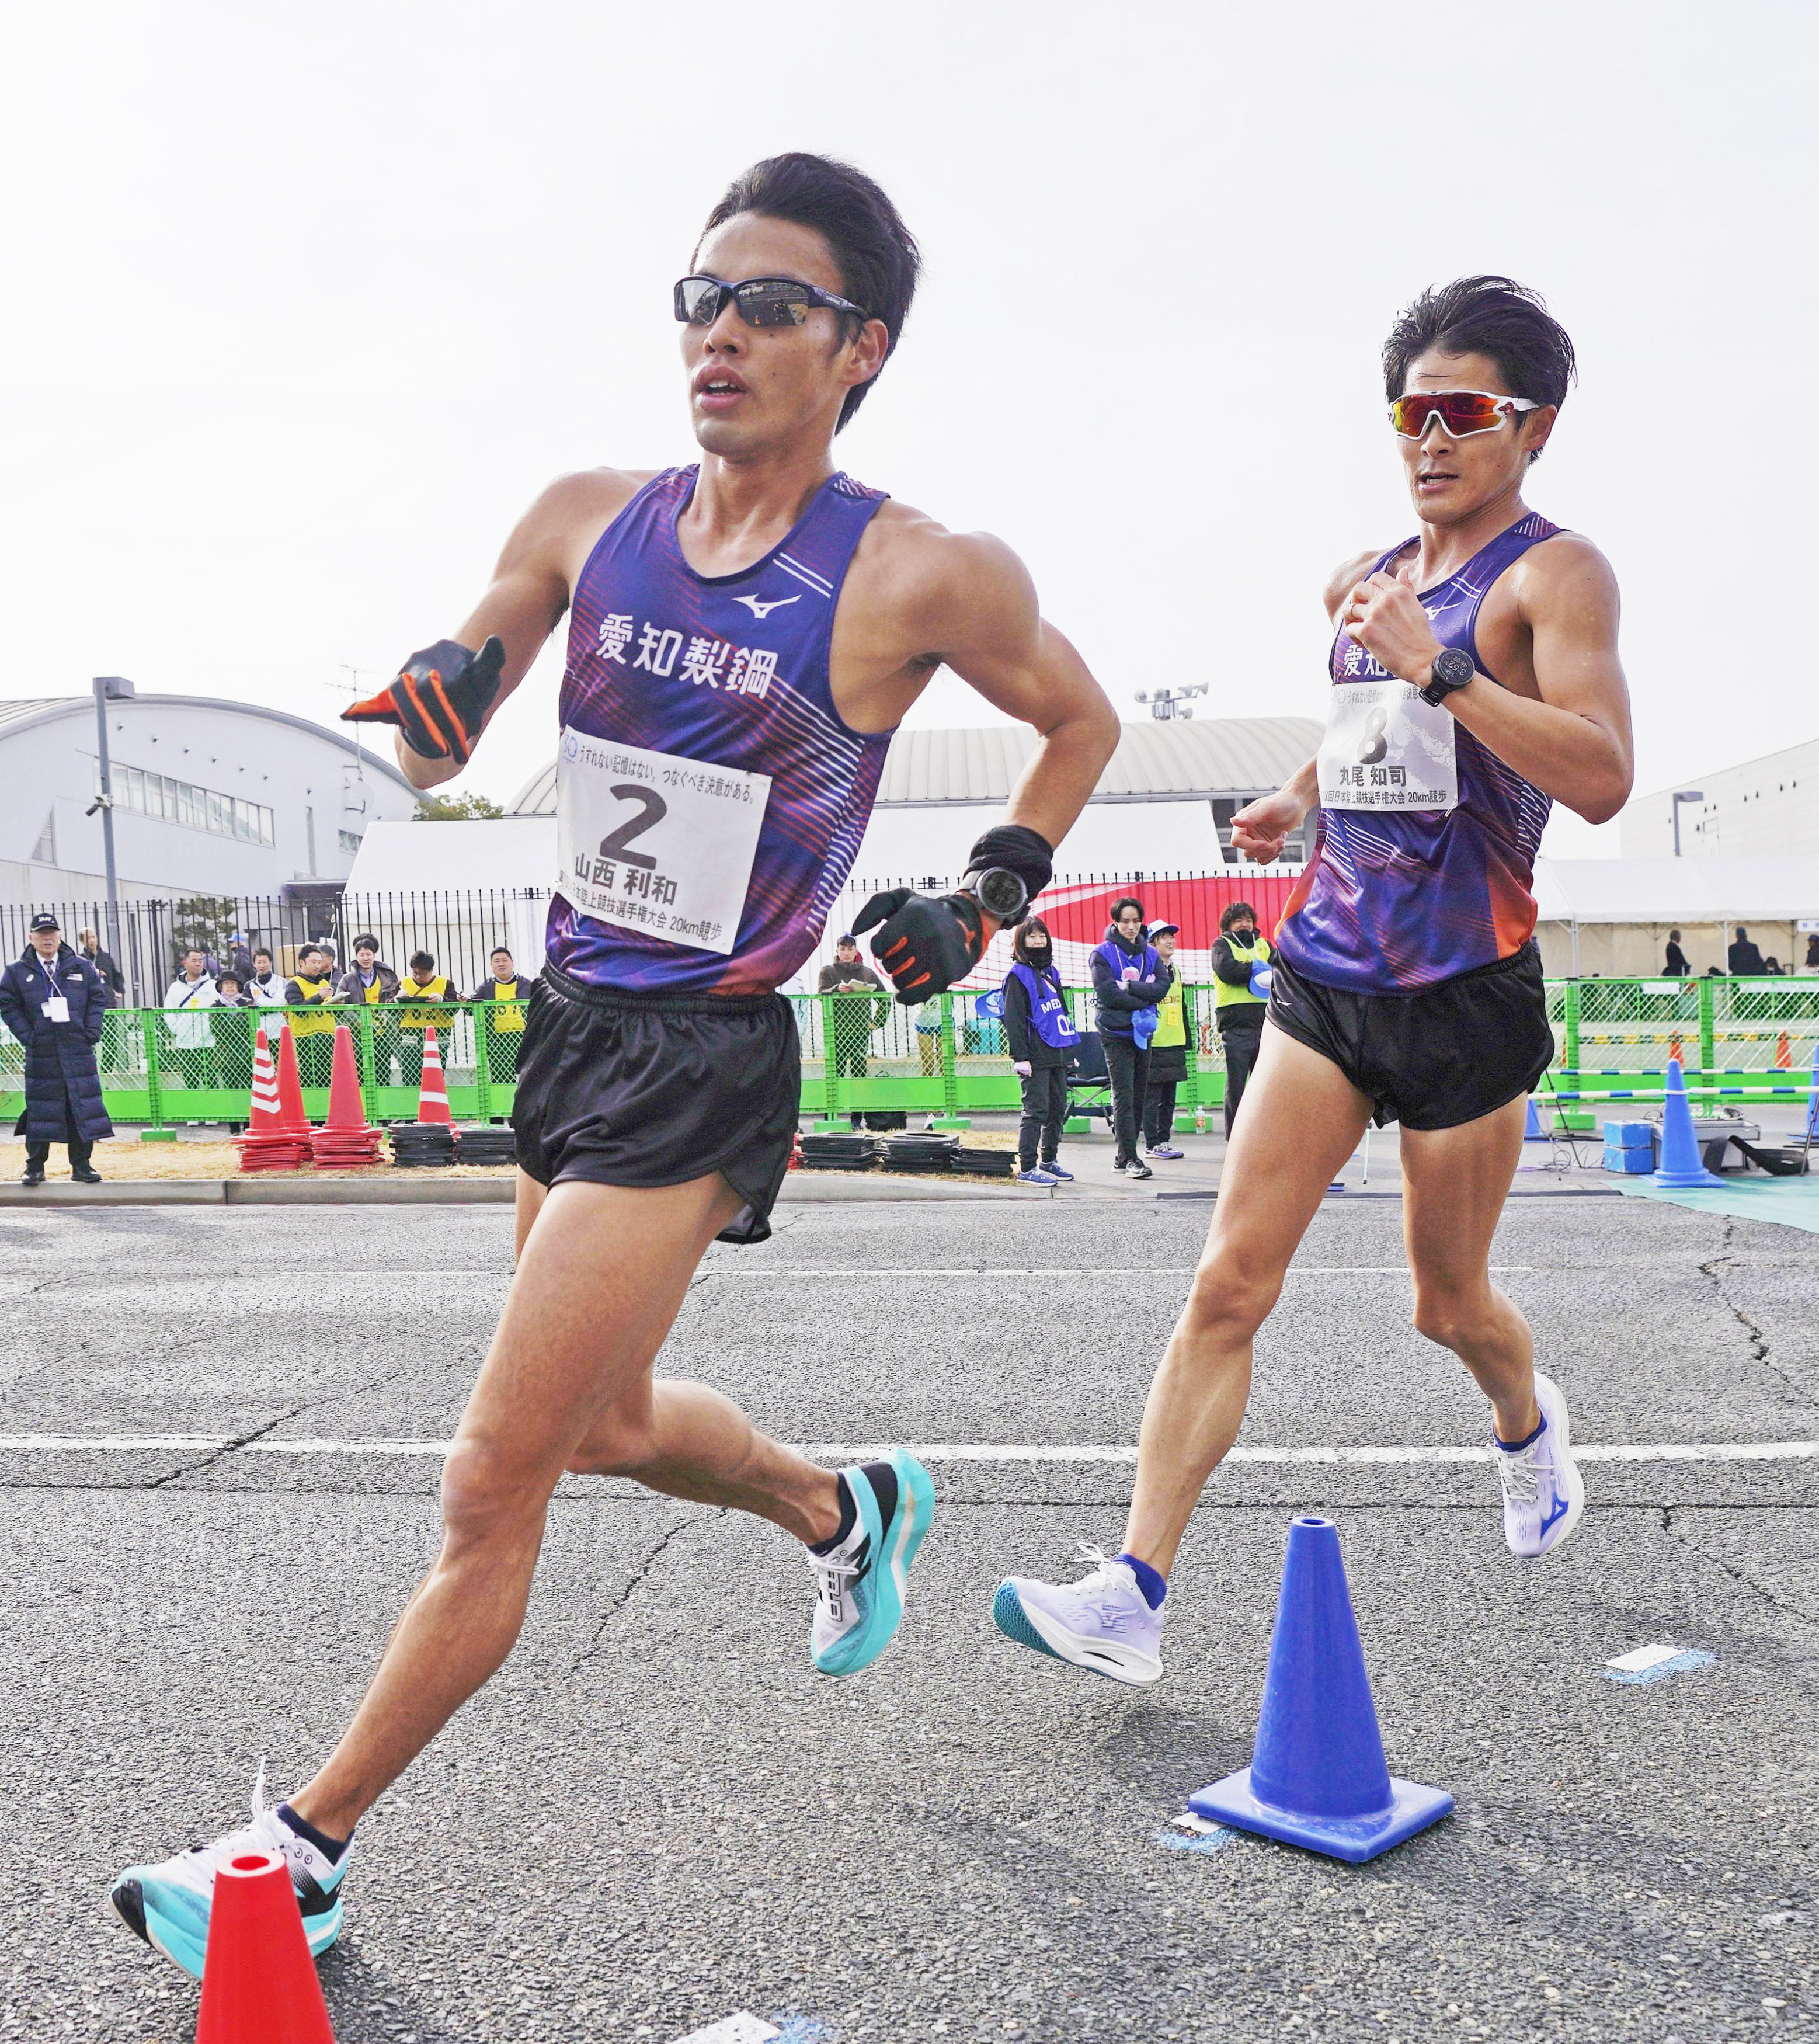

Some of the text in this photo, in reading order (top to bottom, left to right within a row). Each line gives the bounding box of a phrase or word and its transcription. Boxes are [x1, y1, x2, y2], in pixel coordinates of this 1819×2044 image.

[596, 613, 778, 700] 愛知製鋼
[1357, 707, 1388, 765] 8
[1339, 765, 1407, 787] 丸尾 知司
[599, 784, 667, 870] 2
[575, 853, 617, 889] 山西
[623, 868, 678, 906] 利和
